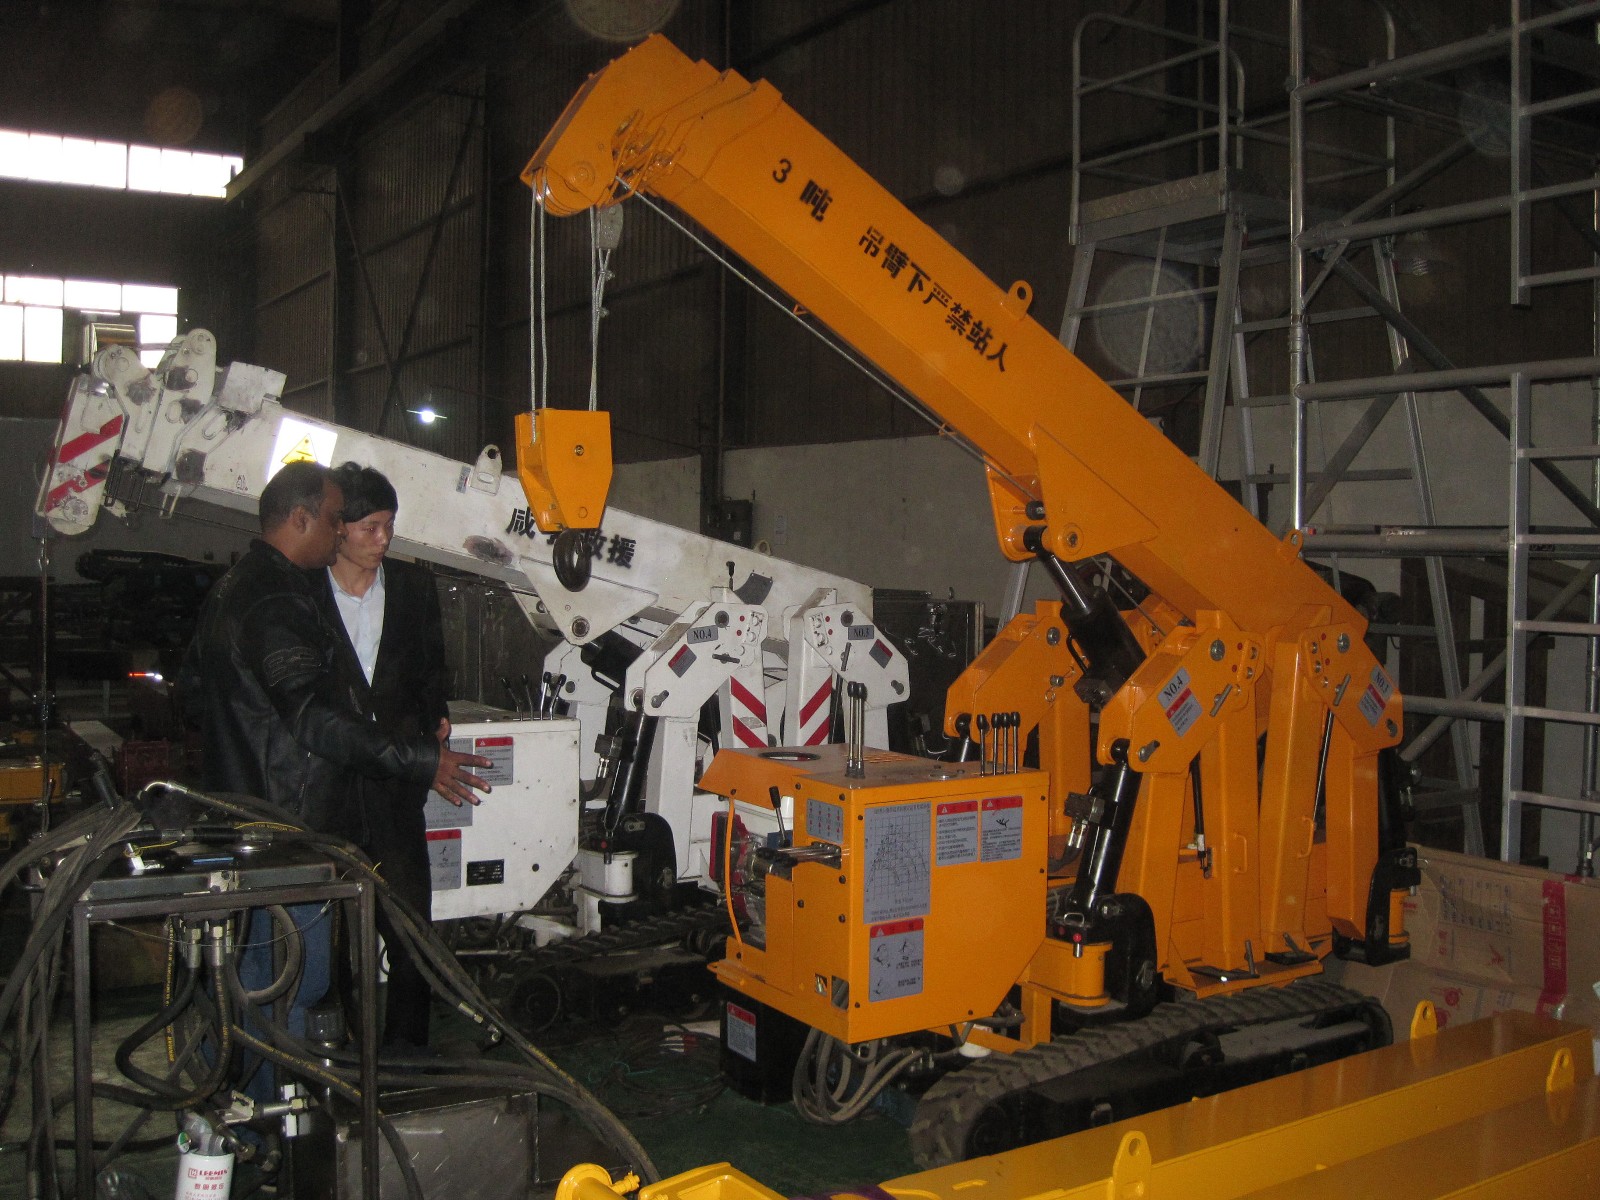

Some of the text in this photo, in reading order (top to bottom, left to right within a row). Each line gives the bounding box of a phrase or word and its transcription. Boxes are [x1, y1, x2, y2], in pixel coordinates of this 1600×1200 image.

[772, 158, 1009, 372] 3 吨 吊臂下严禁站人
[692, 628, 713, 640] NO.4
[1163, 674, 1184, 702] NO.4
